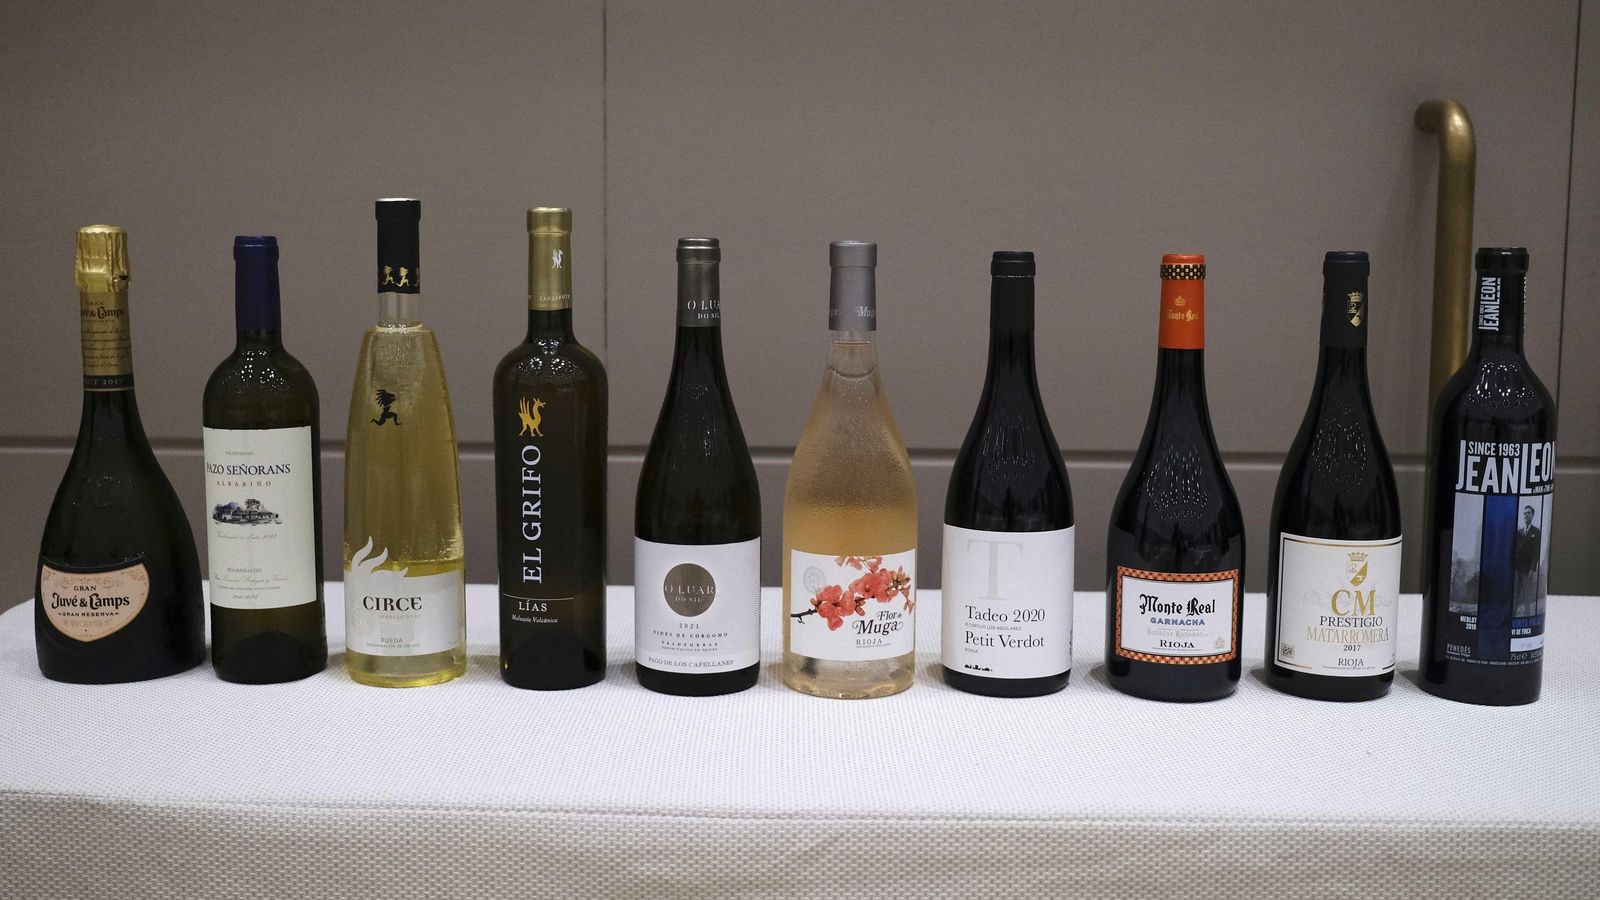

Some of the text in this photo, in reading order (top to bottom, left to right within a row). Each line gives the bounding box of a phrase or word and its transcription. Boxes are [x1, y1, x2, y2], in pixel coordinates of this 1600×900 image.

[687, 299, 697, 310] O
[697, 312, 709, 320] DO
[1467, 441, 1520, 457] SINCE 1963
[206, 462, 291, 476] PAZO SEÑORANS
[521, 444, 542, 584] EL GRIFO
[967, 538, 1024, 601] T
[664, 585, 715, 595] O LUAR
[51, 592, 130, 610] Juvé & Camps
[362, 595, 423, 612] CIRCE
[518, 599, 548, 612] LÍAS
[1139, 593, 1216, 617] Monte Real
[1331, 589, 1377, 617] CM
[875, 610, 898, 621] Flor
[965, 604, 1046, 623] Tadeo 2020
[1460, 615, 1478, 624] MERLOT
[679, 622, 700, 630] 2021
[852, 619, 904, 636] Muga
[1150, 617, 1206, 626] GARNACHA
[1319, 615, 1383, 628] PRESTIGIO
[965, 630, 1045, 648] Petit Verdot
[1306, 625, 1389, 644] MATARROMERA
[856, 638, 883, 646] RIOJA
[1159, 639, 1195, 649] RIOJA
[1343, 644, 1362, 652] 2017
[648, 656, 664, 665] PAGO
[674, 660, 688, 668] LOS
[688, 659, 734, 668] CAPELLANES
[1337, 658, 1364, 668] RIOJA
